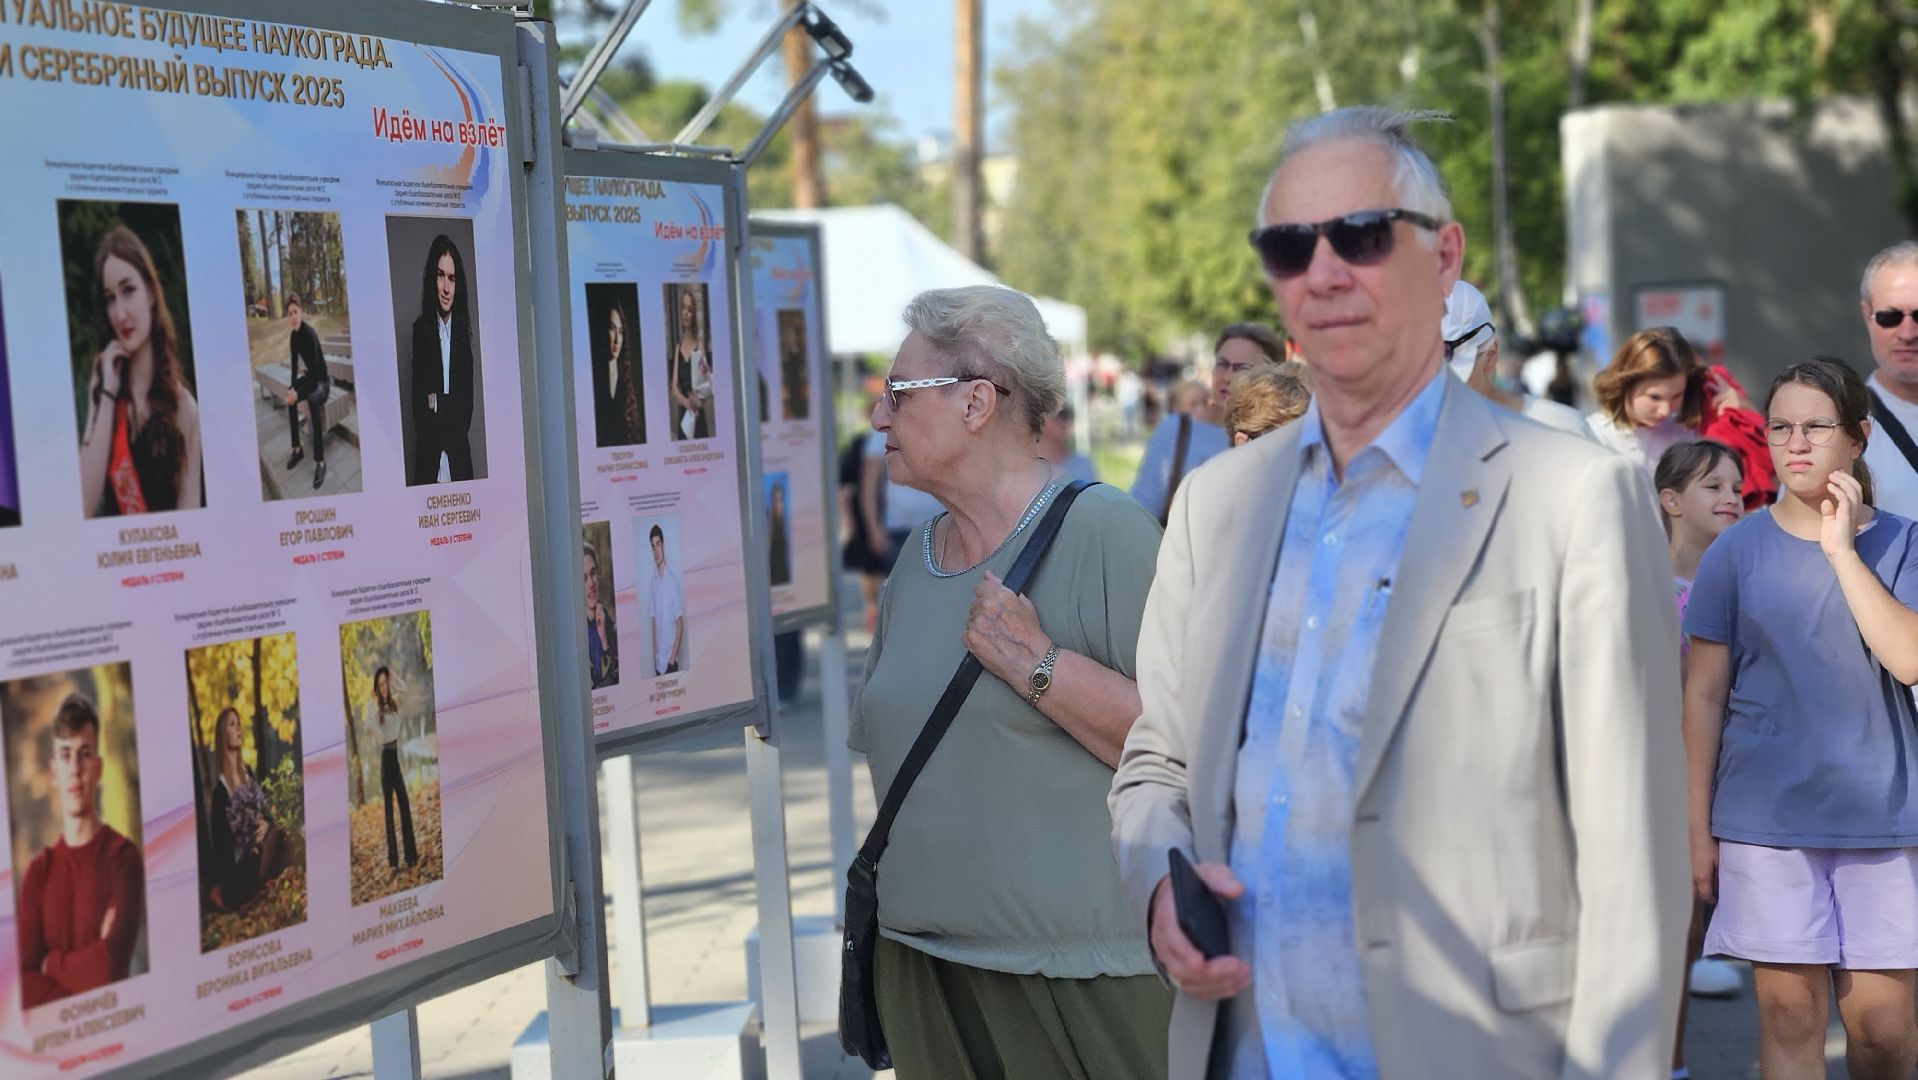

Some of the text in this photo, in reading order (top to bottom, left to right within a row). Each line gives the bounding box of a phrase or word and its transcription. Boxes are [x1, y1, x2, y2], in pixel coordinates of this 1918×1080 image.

[139, 7, 247, 53] БУДУЩЕЕ
[251, 22, 393, 70] НАУКОГРАДА.
[19, 44, 190, 94] СЕРЕБРЯНЫЙ
[193, 63, 289, 103] ВЫПУСК
[292, 73, 345, 108] 2025
[373, 106, 505, 147] Идём на взлёт
[612, 206, 641, 223] 2025
[426, 492, 472, 510] СЕМЕНЕНКО
[295, 507, 336, 526] ПРОШИН
[418, 508, 481, 529] ИВАН СЕРГЕЕВИЧ
[279, 524, 354, 547] ЕГОР ПАВЛОВИЧ
